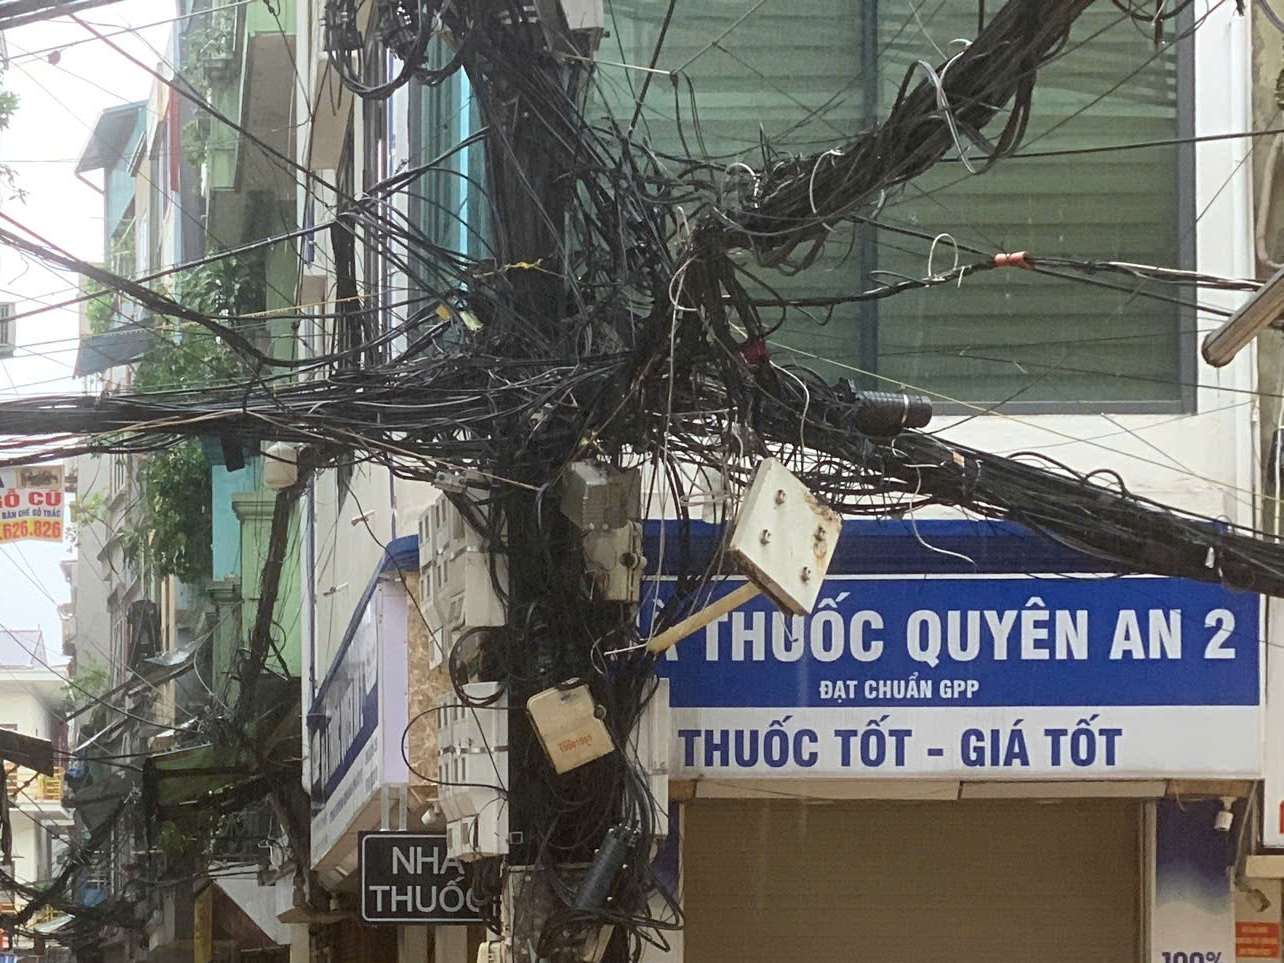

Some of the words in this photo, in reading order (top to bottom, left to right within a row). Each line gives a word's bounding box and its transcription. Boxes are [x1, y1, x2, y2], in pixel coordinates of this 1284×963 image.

[28, 489, 62, 507] CŨ
[705, 592, 884, 662] THUỐC
[906, 596, 1089, 668] QUYÊN
[1109, 609, 1182, 660] AN
[1203, 608, 1237, 660] 2
[819, 680, 858, 704] ĐẠT
[864, 671, 932, 699] CHUẨN
[939, 679, 979, 699] GPP
[678, 714, 819, 767] THUỐC
[834, 714, 912, 767] TỐT
[960, 718, 1030, 767] GIÁ
[1044, 713, 1123, 767] TỐT
